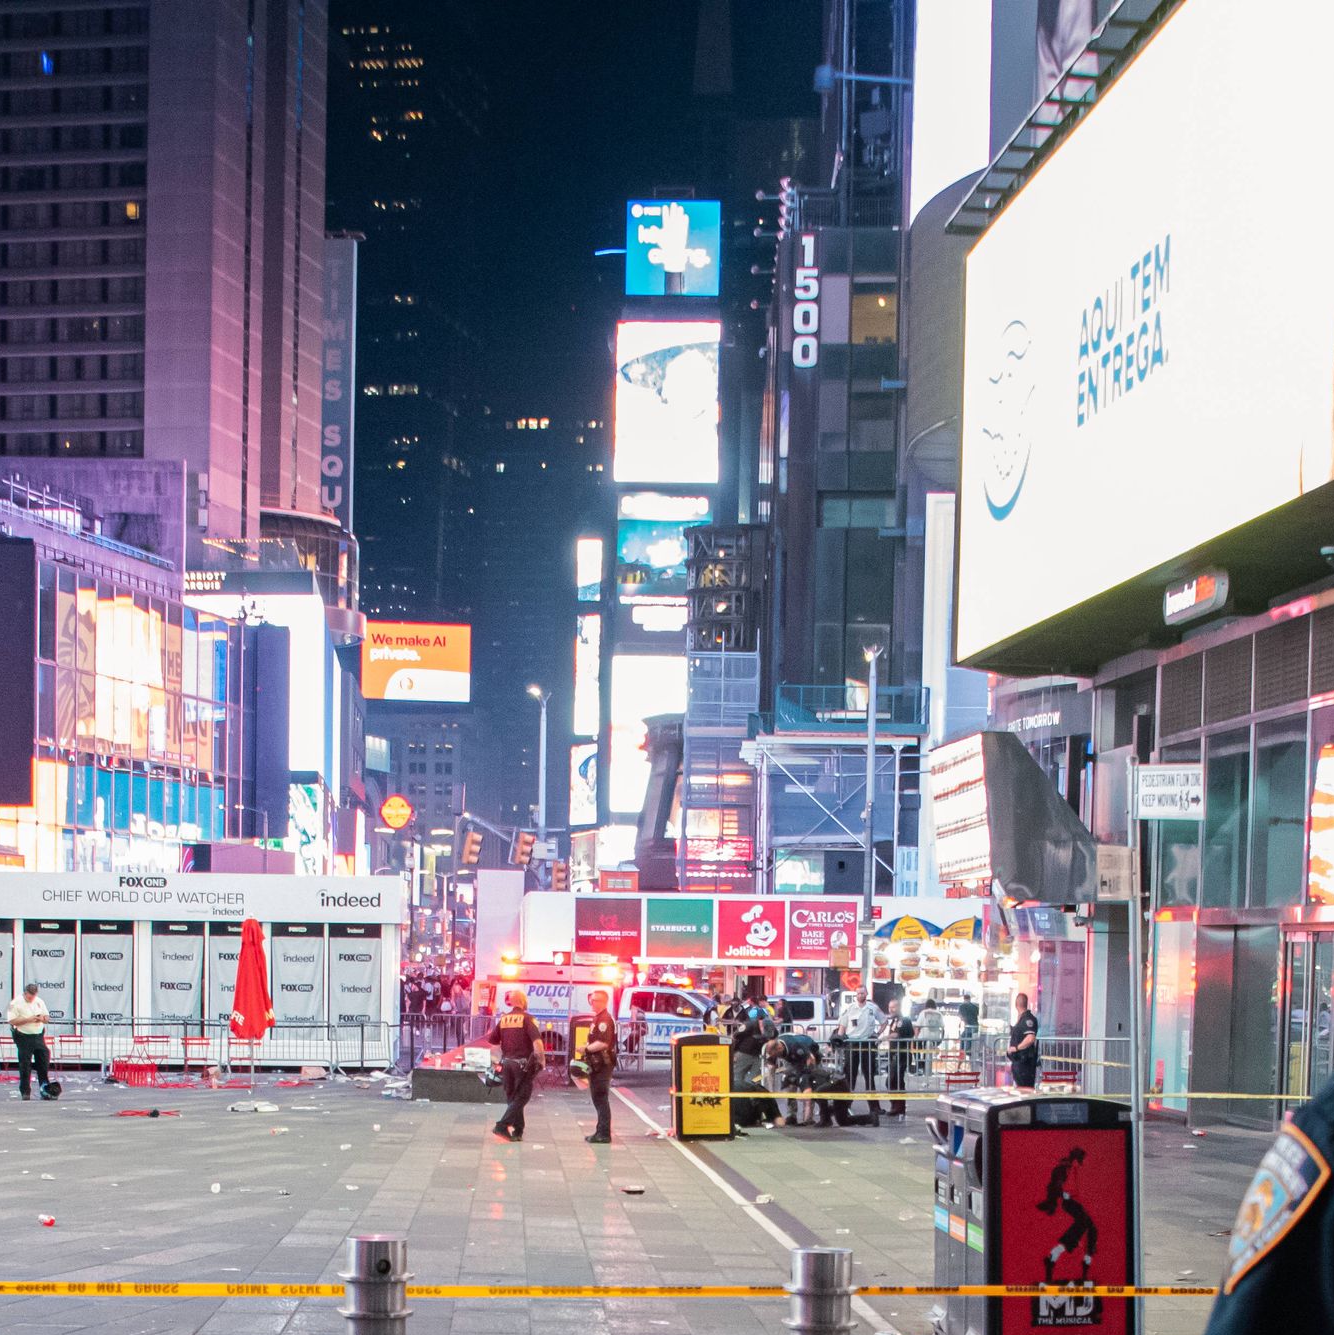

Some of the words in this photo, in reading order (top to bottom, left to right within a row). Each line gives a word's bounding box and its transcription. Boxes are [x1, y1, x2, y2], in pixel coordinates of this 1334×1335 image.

[793, 235, 819, 368] 1500
[1078, 276, 1123, 366] AQUI
[1131, 234, 1170, 320] TEM
[322, 257, 346, 400] TIMES
[1077, 310, 1168, 428] ENTREGA.
[321, 424, 343, 507] SQU
[184, 572, 226, 580] ARRIOTT
[184, 581, 221, 590] ARQUIS
[371, 633, 393, 645] We
[395, 635, 430, 647] make
[433, 636, 446, 647] AI
[1023, 711, 1060, 730] TOMORROW
[1142, 774, 1175, 787] PEDESTRIAN
[1176, 774, 1189, 786] FLOW
[1142, 794, 1155, 807] KEEP
[1158, 794, 1178, 807] MOVING
[119, 876, 144, 888] FOX
[145, 876, 166, 888] ONE
[43, 890, 82, 902] CHIEF
[88, 890, 139, 902] WORLD
[144, 892, 172, 904] CUP
[177, 892, 244, 904] WATCHER
[317, 889, 381, 907] indeed
[212, 907, 244, 916] indeed
[792, 909, 855, 928] CARLO'S
[651, 925, 696, 933] STARBUCKS
[90, 952, 106, 960] FOX
[163, 953, 194, 961] indeed
[725, 945, 771, 958] Jollibee
[283, 954, 315, 963] indeed
[339, 954, 355, 962] FOX
[92, 983, 123, 991] indeed
[160, 982, 176, 990] FOX
[281, 984, 298, 992] FOX
[341, 984, 372, 993] indeed
[527, 985, 574, 997] POLICE
[219, 1013, 230, 1021] FO
[339, 1014, 355, 1022] FOX
[501, 1014, 523, 1025] NYPD
[1039, 1281, 1094, 1317] MJ
[1056, 1317, 1092, 1325] MUSICAL
